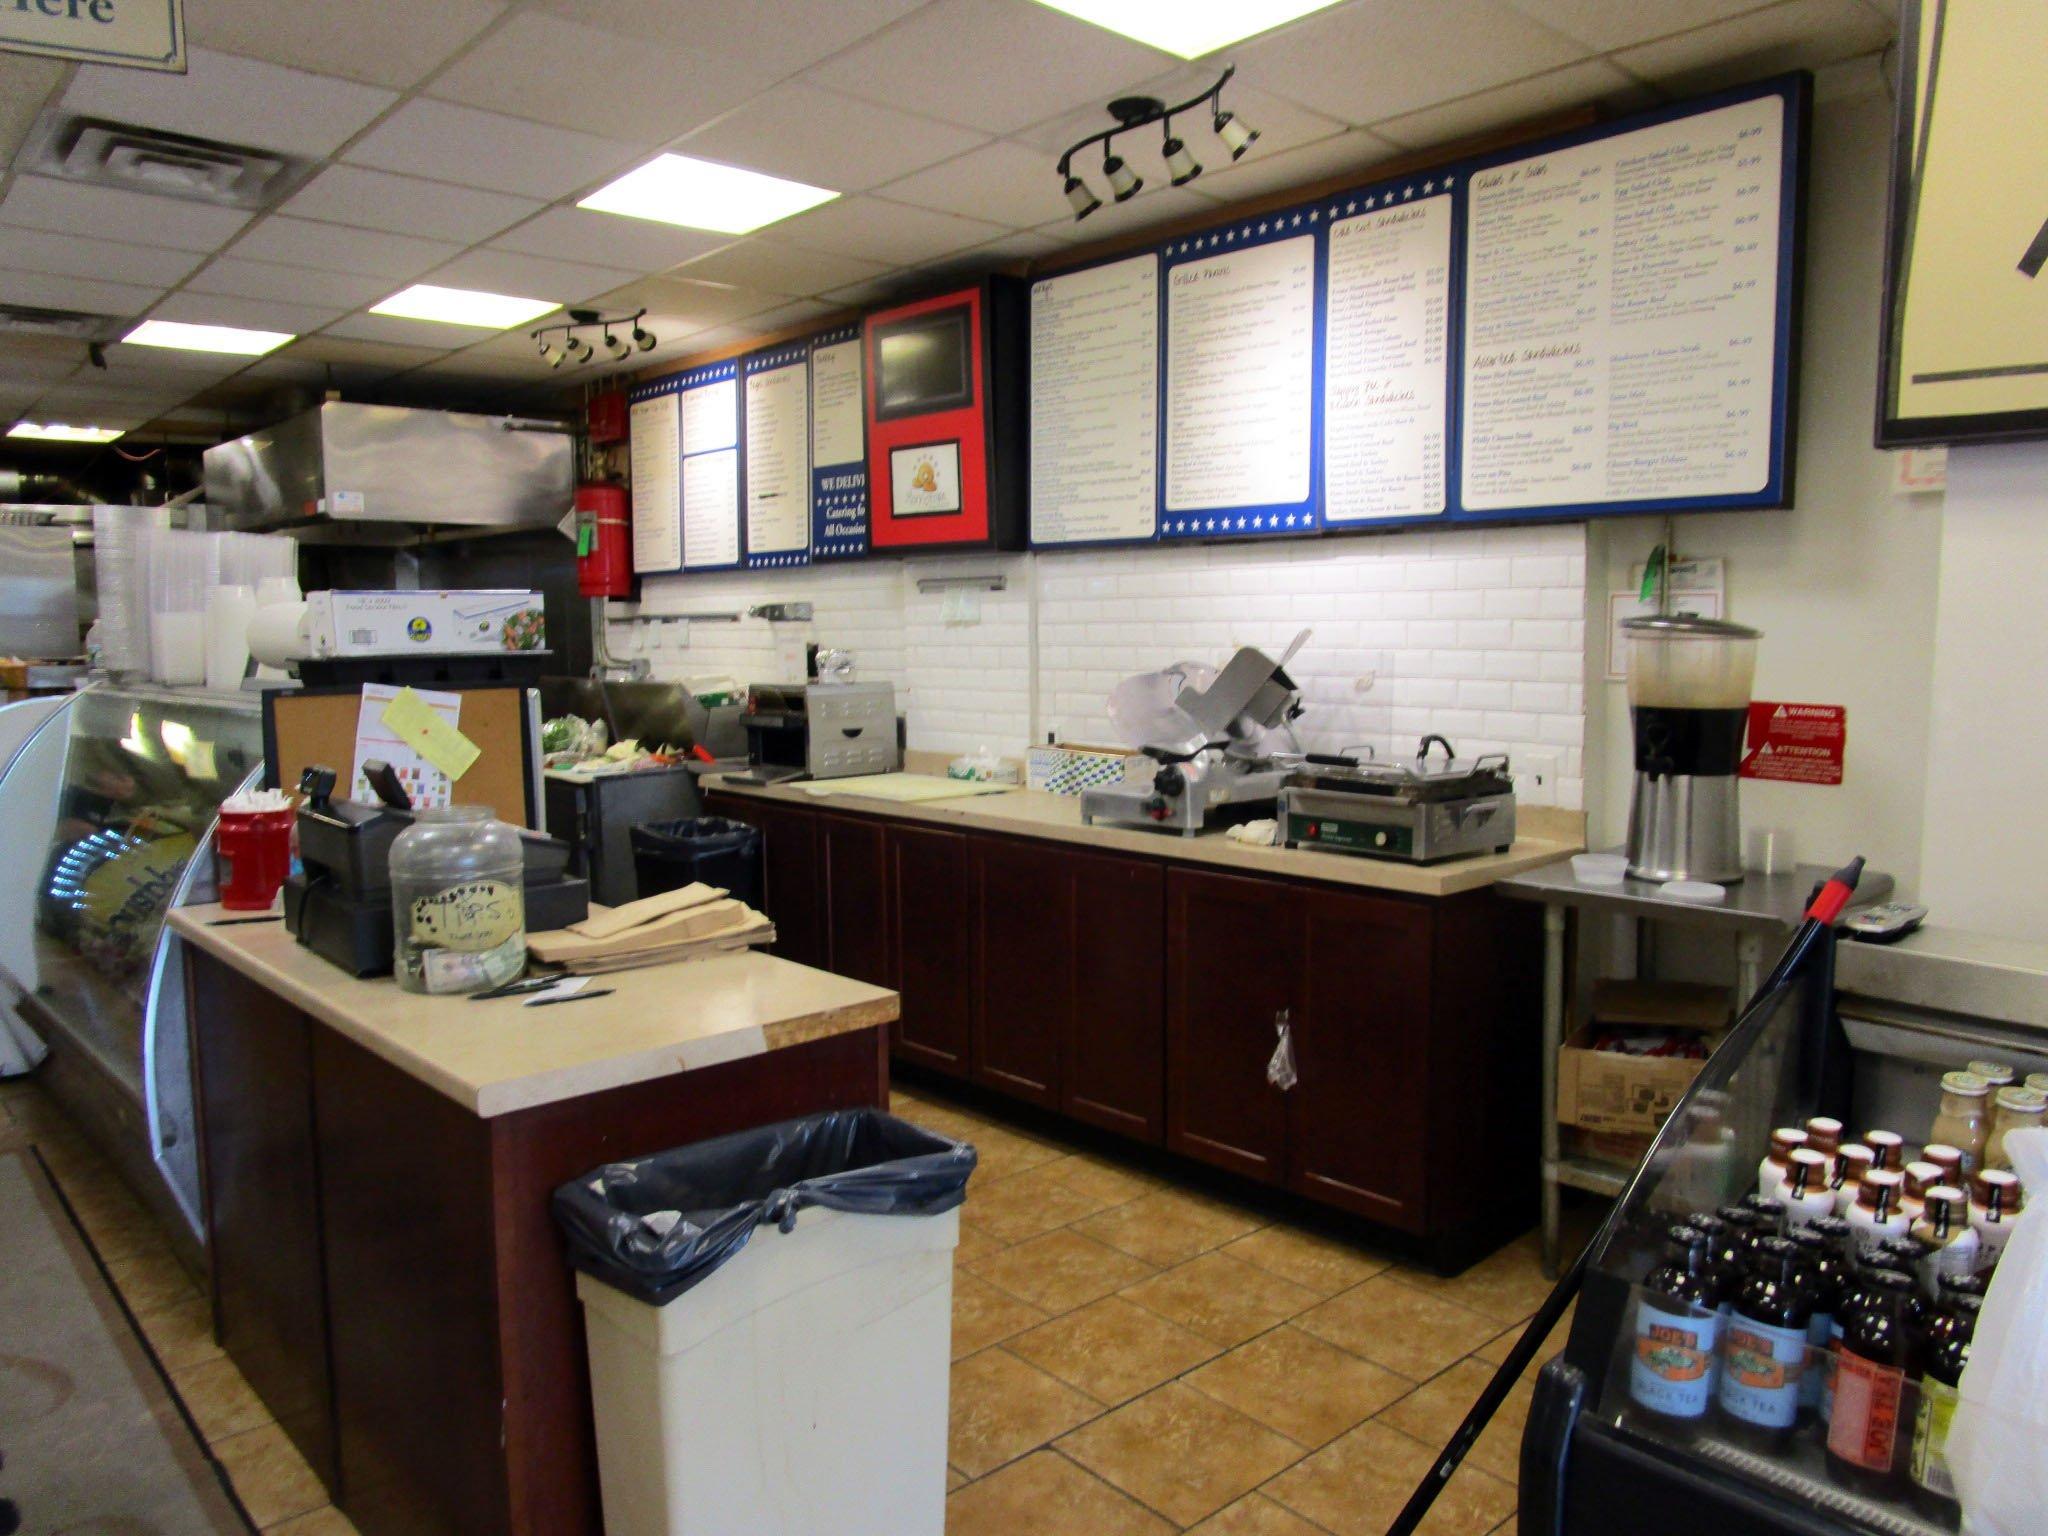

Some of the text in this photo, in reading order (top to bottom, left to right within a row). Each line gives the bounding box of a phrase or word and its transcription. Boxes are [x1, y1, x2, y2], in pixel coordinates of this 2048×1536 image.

[821, 477, 835, 492] WE
[826, 505, 857, 521] Catering
[824, 522, 835, 538] All
[1788, 706, 1837, 719] WARNING
[1775, 745, 1832, 758] ATTENTION
[1752, 1396, 1777, 1415] TEA
